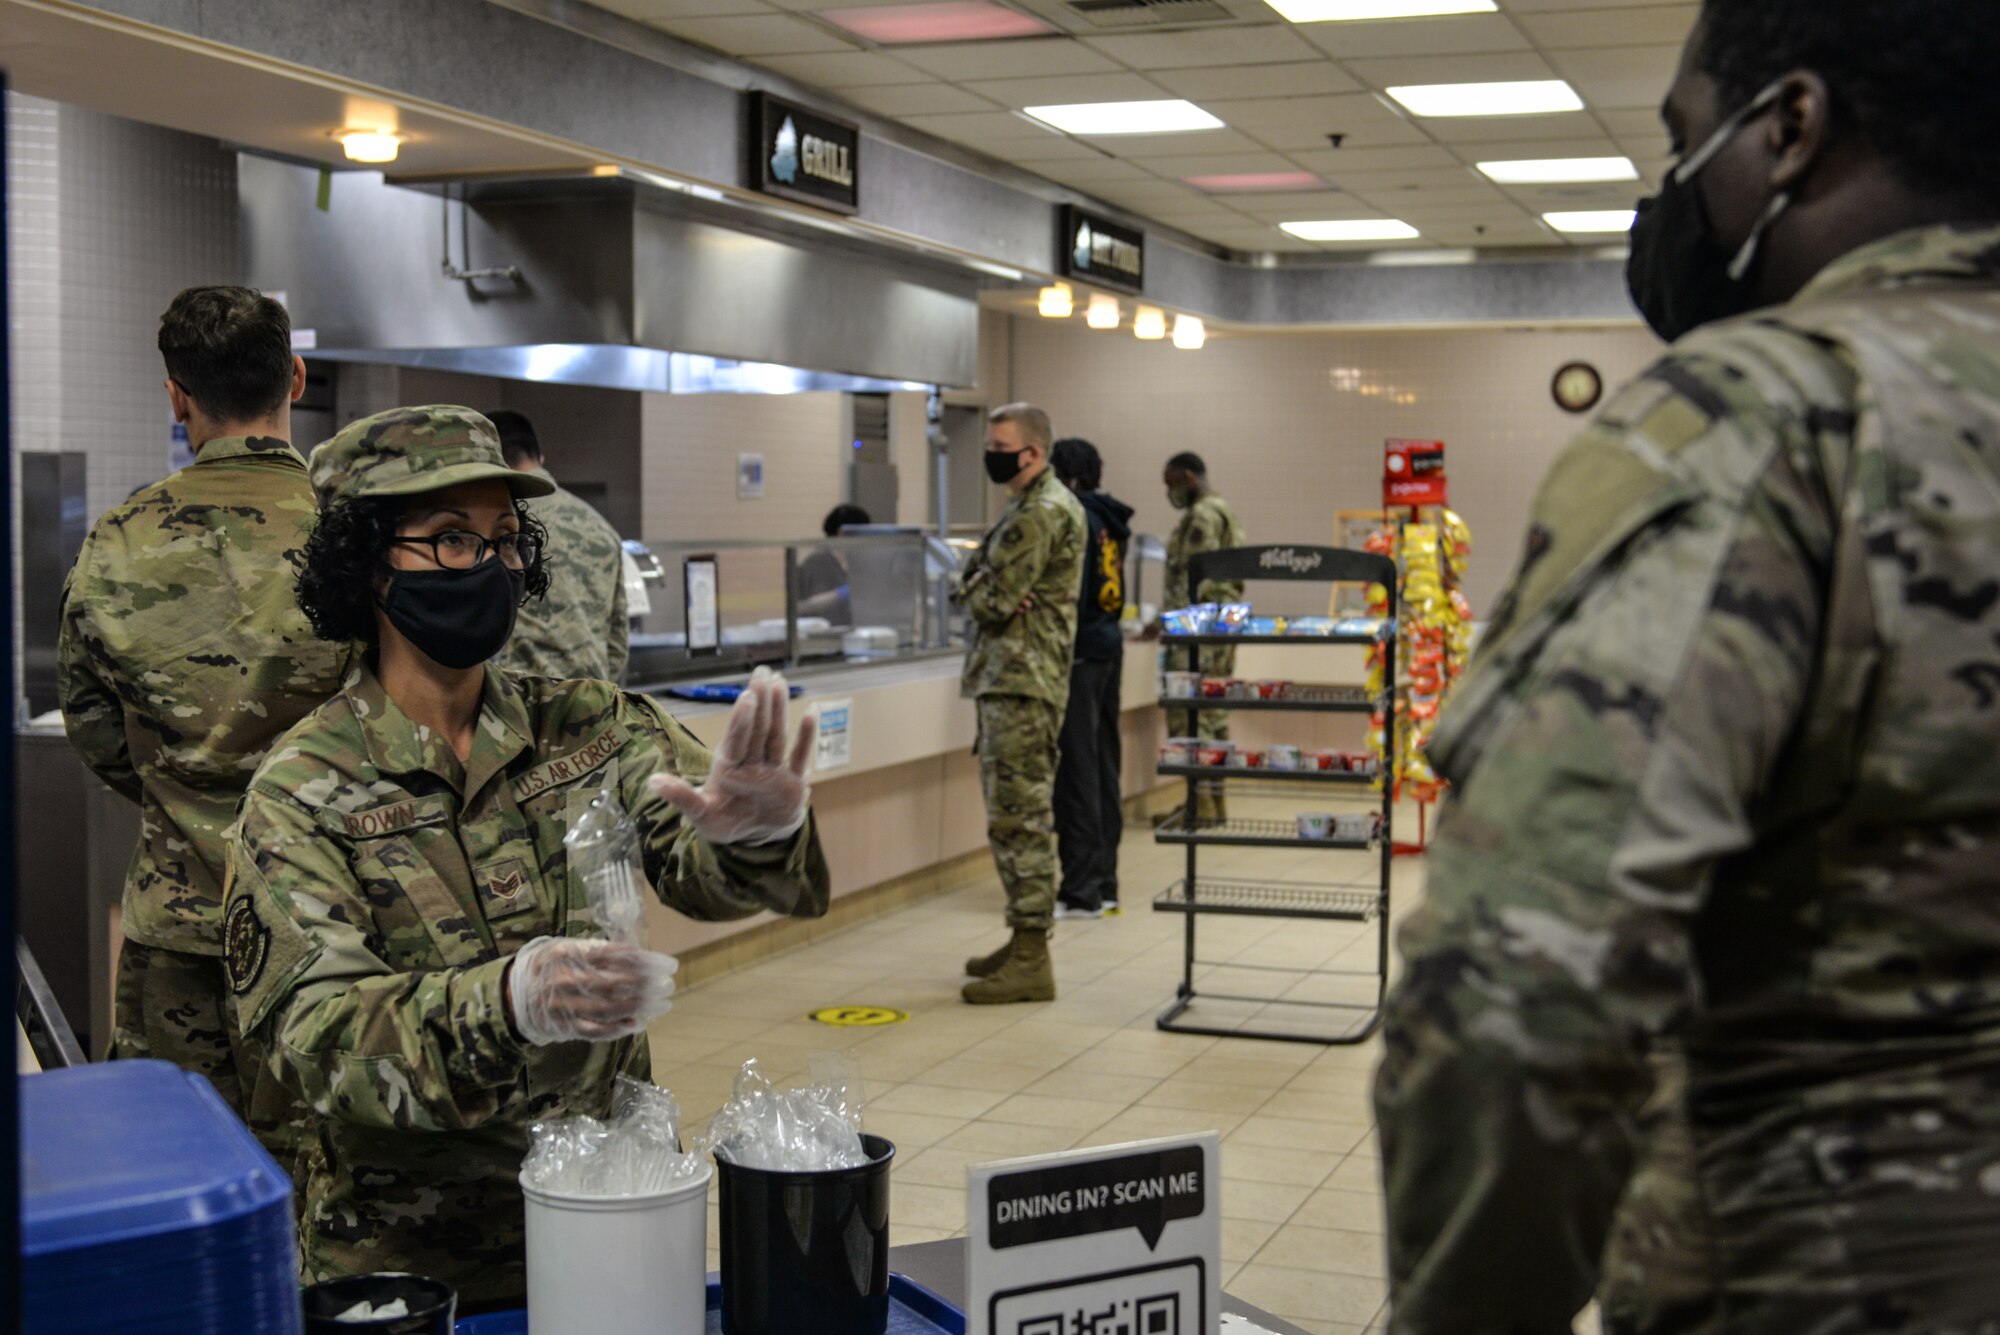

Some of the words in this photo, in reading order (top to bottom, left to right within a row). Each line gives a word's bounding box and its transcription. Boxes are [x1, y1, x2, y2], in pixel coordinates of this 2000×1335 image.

[801, 134, 852, 186] GRILL
[514, 770, 549, 796] U.S.
[548, 760, 574, 782] AIR
[570, 729, 621, 772] FORCE
[996, 1191, 1072, 1223] DINING
[1075, 1185, 1109, 1211] IN?
[1113, 1177, 1164, 1204] SCAN
[1168, 1171, 1198, 1196] ME
